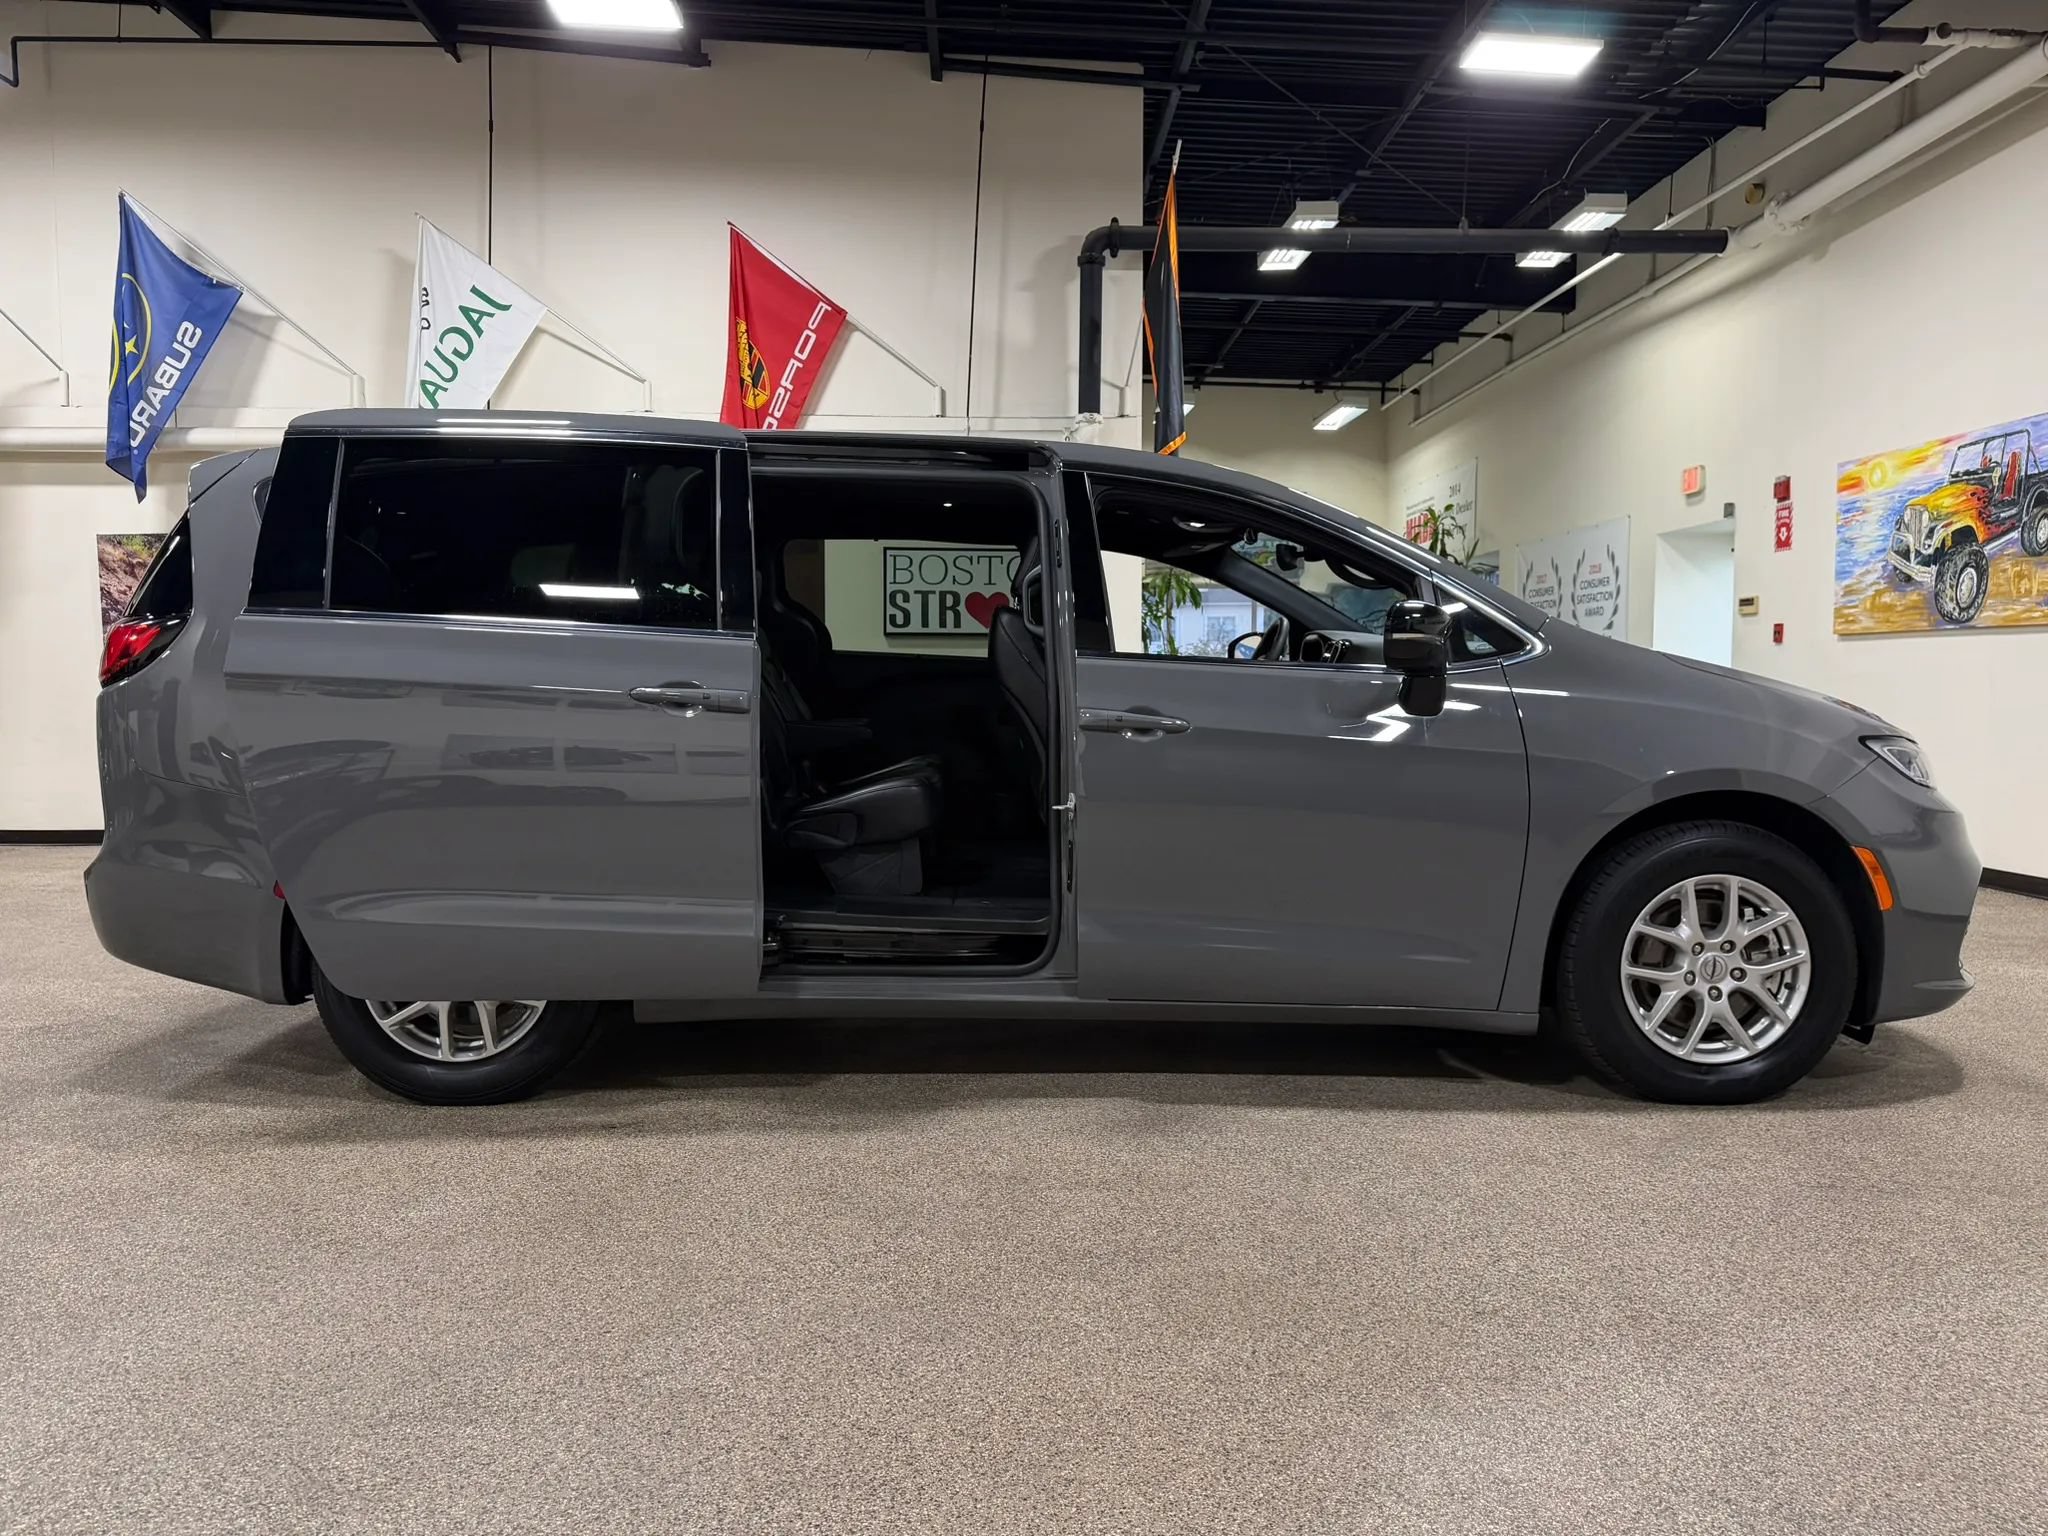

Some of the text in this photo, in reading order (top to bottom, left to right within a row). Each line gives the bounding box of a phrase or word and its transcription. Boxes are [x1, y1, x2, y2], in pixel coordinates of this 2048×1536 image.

[1580, 577, 1611, 591] CONSUMER
[1528, 586, 1554, 598] CONSUMER
[1576, 591, 1614, 605] SATISFACTION
[1584, 606, 1605, 618] AWARD
